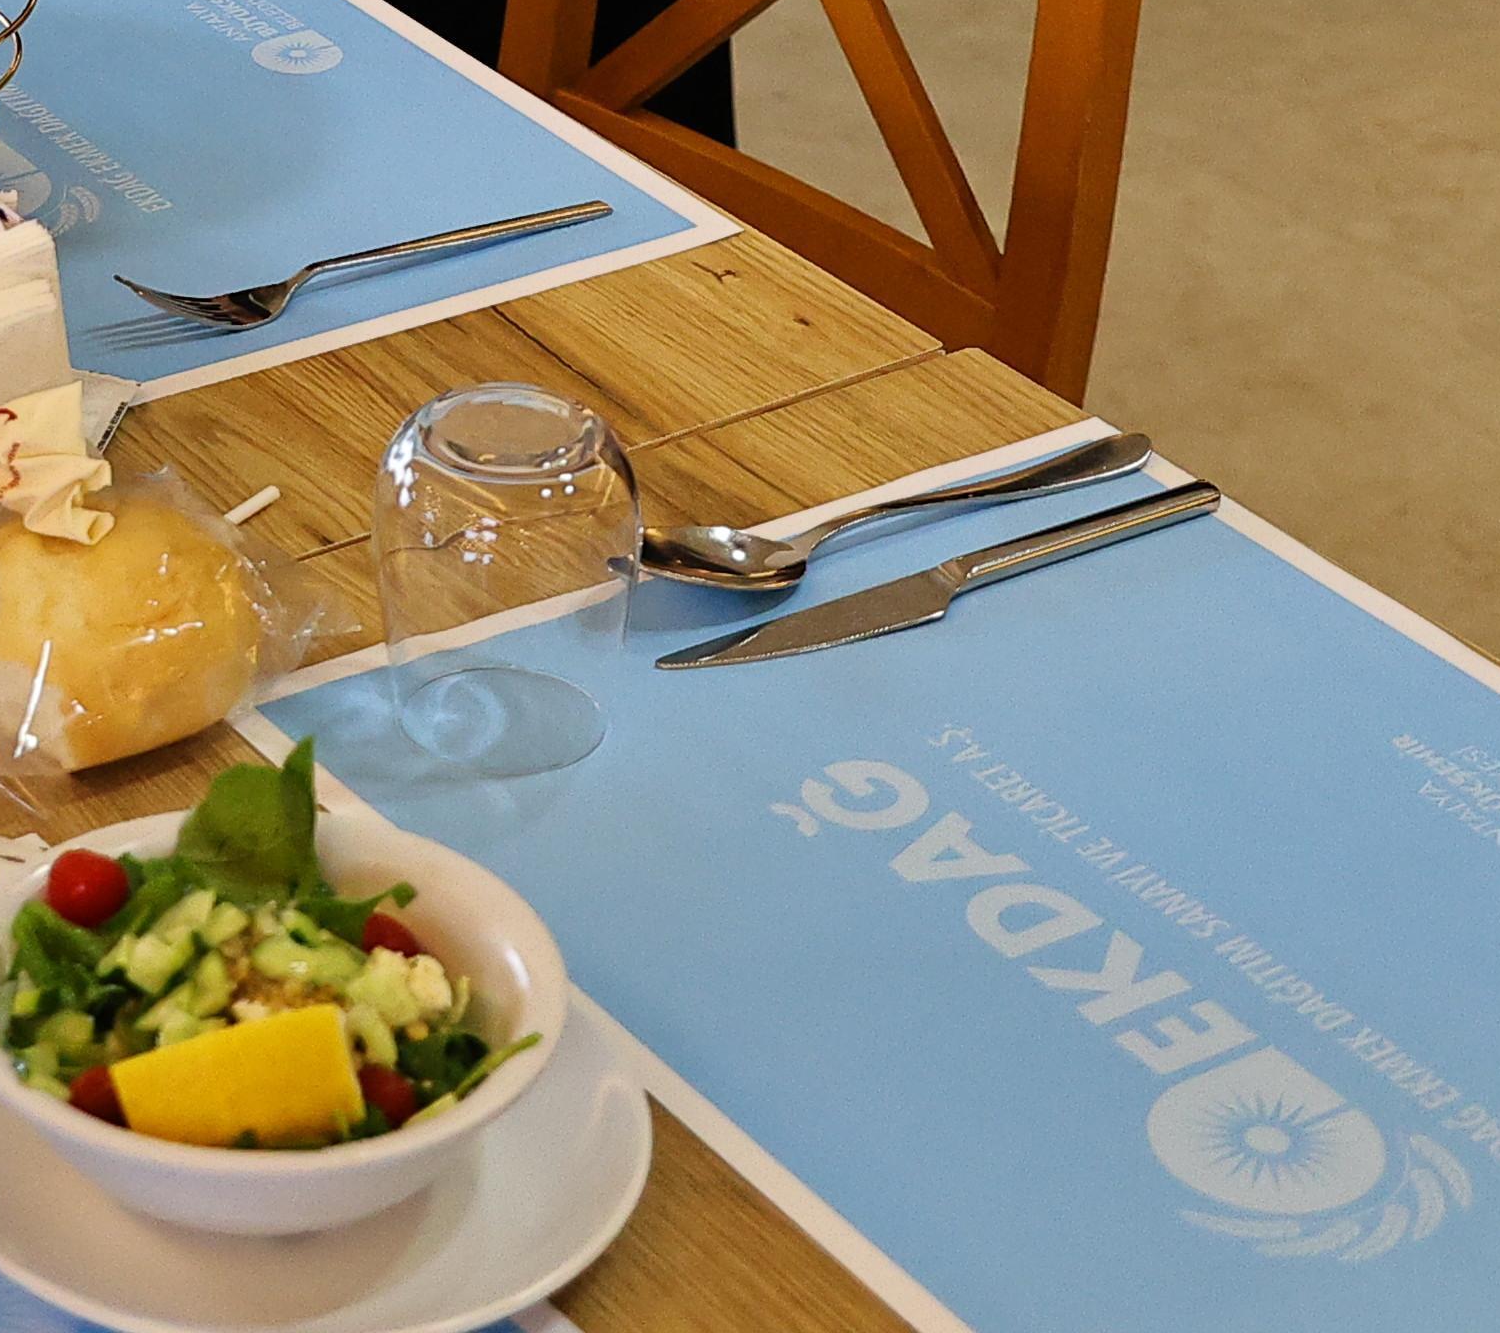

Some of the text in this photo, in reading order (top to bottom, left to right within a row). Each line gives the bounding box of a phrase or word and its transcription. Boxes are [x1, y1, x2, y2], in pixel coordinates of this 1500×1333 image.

[970, 763, 1091, 843] TİCARET
[1075, 836, 1129, 869] VE
[770, 758, 1260, 1075] EKDAĞ
[1213, 934, 1356, 1032] DAĞITIM
[1337, 1027, 1462, 1110] EKMEK
